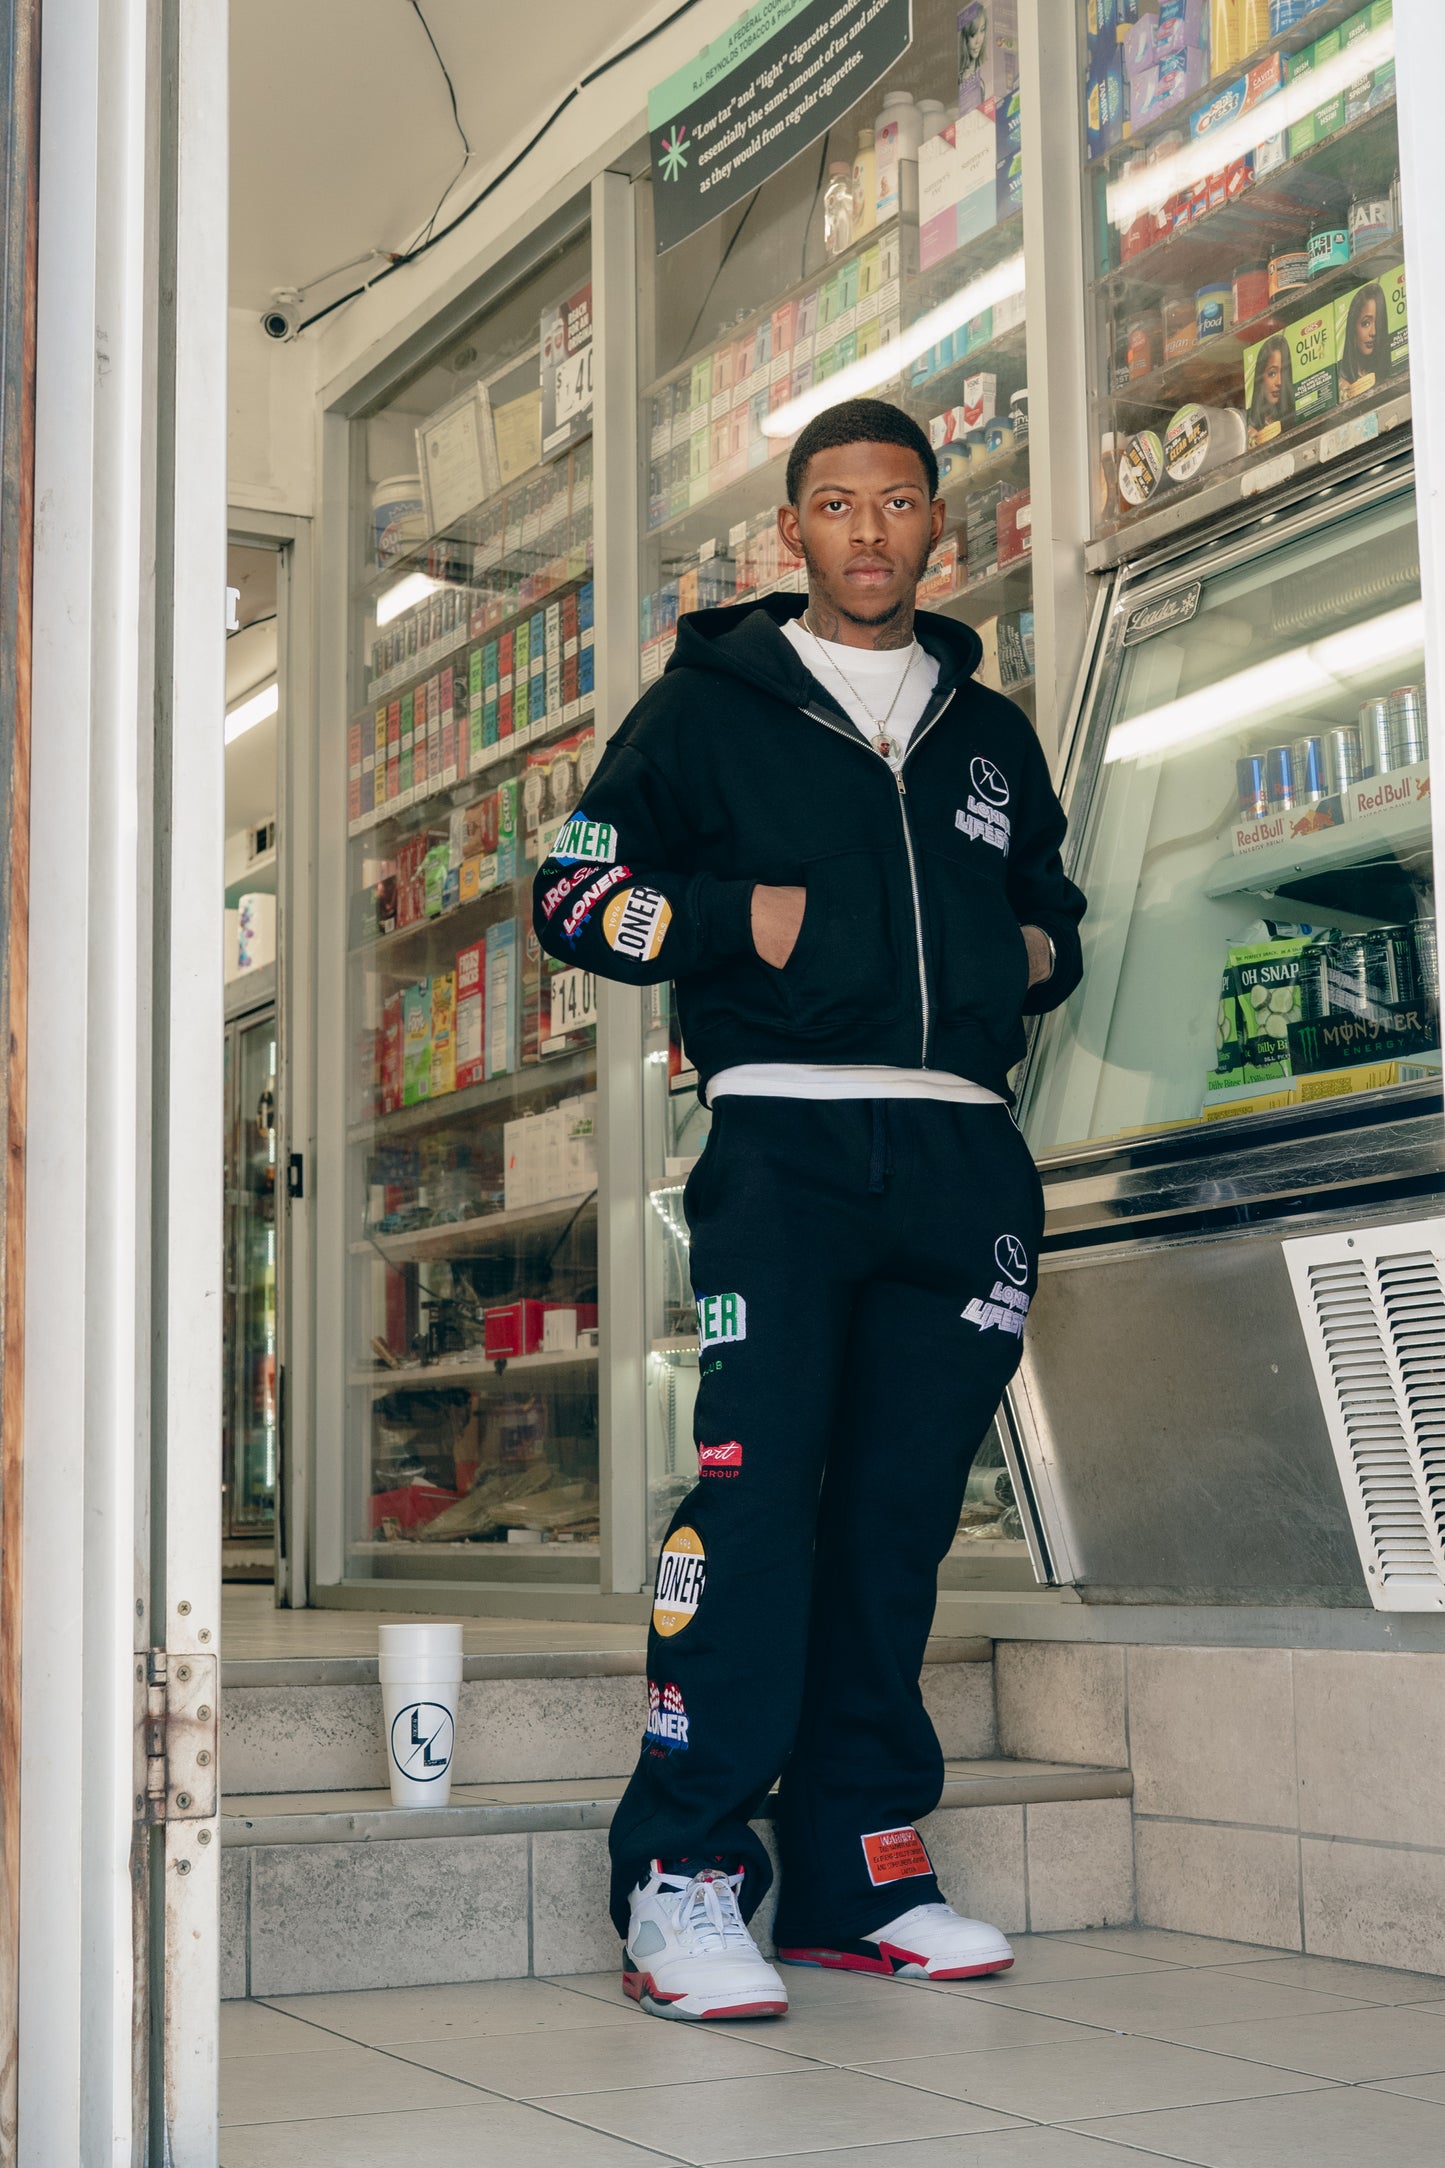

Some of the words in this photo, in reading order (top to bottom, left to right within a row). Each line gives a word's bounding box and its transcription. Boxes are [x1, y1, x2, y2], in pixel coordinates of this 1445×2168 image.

[733, 13, 762, 43] FEDERAL
[705, 47, 739, 81] REYNOLDS
[740, 20, 770, 52] TOBACCO
[737, 82, 755, 108] and
[789, 22, 829, 64] cigarette
[698, 121, 747, 167] essentially
[748, 108, 763, 128] the
[764, 88, 788, 116] same
[788, 54, 824, 94] amount
[824, 41, 835, 63] of
[835, 32, 849, 53] tar
[849, 11, 866, 40] and
[867, 0, 890, 23] nico
[1348, 81, 1371, 100] SPRING
[700, 178, 711, 194] as
[711, 161, 732, 185] they
[733, 135, 762, 169] would
[762, 120, 785, 146] from
[785, 91, 818, 127] regular
[818, 50, 864, 97] cigarettes.
[1197, 93, 1239, 133] Crest
[1203, 316, 1223, 333] food
[1296, 328, 1328, 354] OLIVE
[1300, 351, 1318, 366] OIL
[1357, 786, 1383, 812] Red
[1384, 777, 1411, 804] Bull
[1237, 825, 1259, 847] Red
[1260, 818, 1284, 840] Bull
[541, 877, 571, 918] LRG
[563, 865, 632, 935] LONER
[608, 904, 621, 928] 1996
[613, 885, 662, 961] LONER
[1241, 967, 1258, 986] OH
[1257, 1040, 1276, 1054] Dilly
[1343, 1039, 1405, 1056] ENERGY
[655, 1554, 706, 1606] LONER
[647, 1707, 689, 1743] LONER
